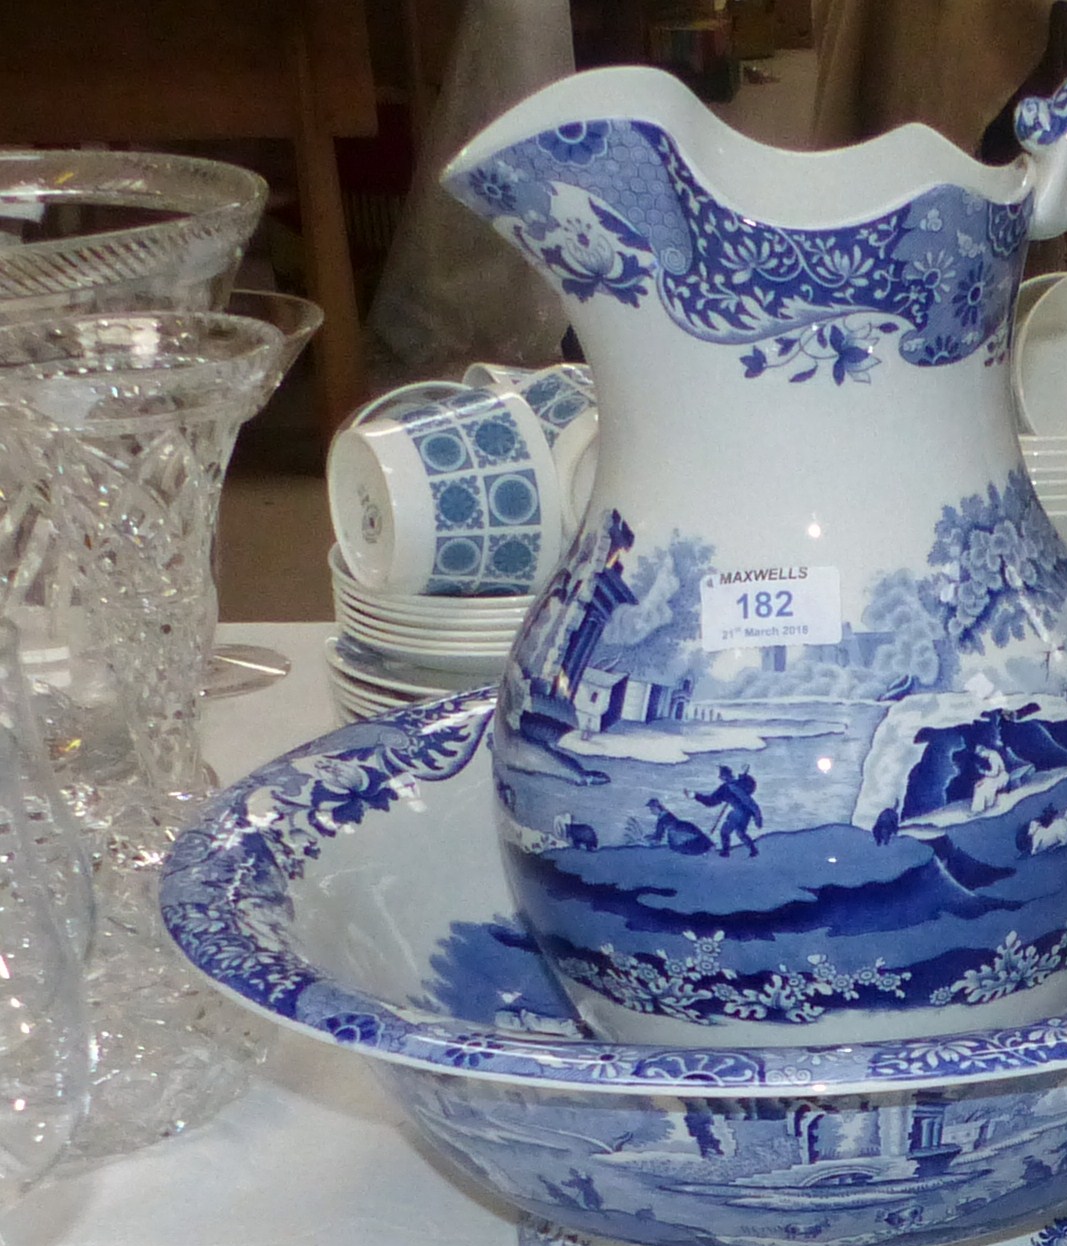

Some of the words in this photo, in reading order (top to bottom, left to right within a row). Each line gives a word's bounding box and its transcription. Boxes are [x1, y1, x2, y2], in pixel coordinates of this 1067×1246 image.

[719, 566, 808, 585] MAXWELLS
[736, 590, 794, 620] 182
[744, 626, 779, 638] March
